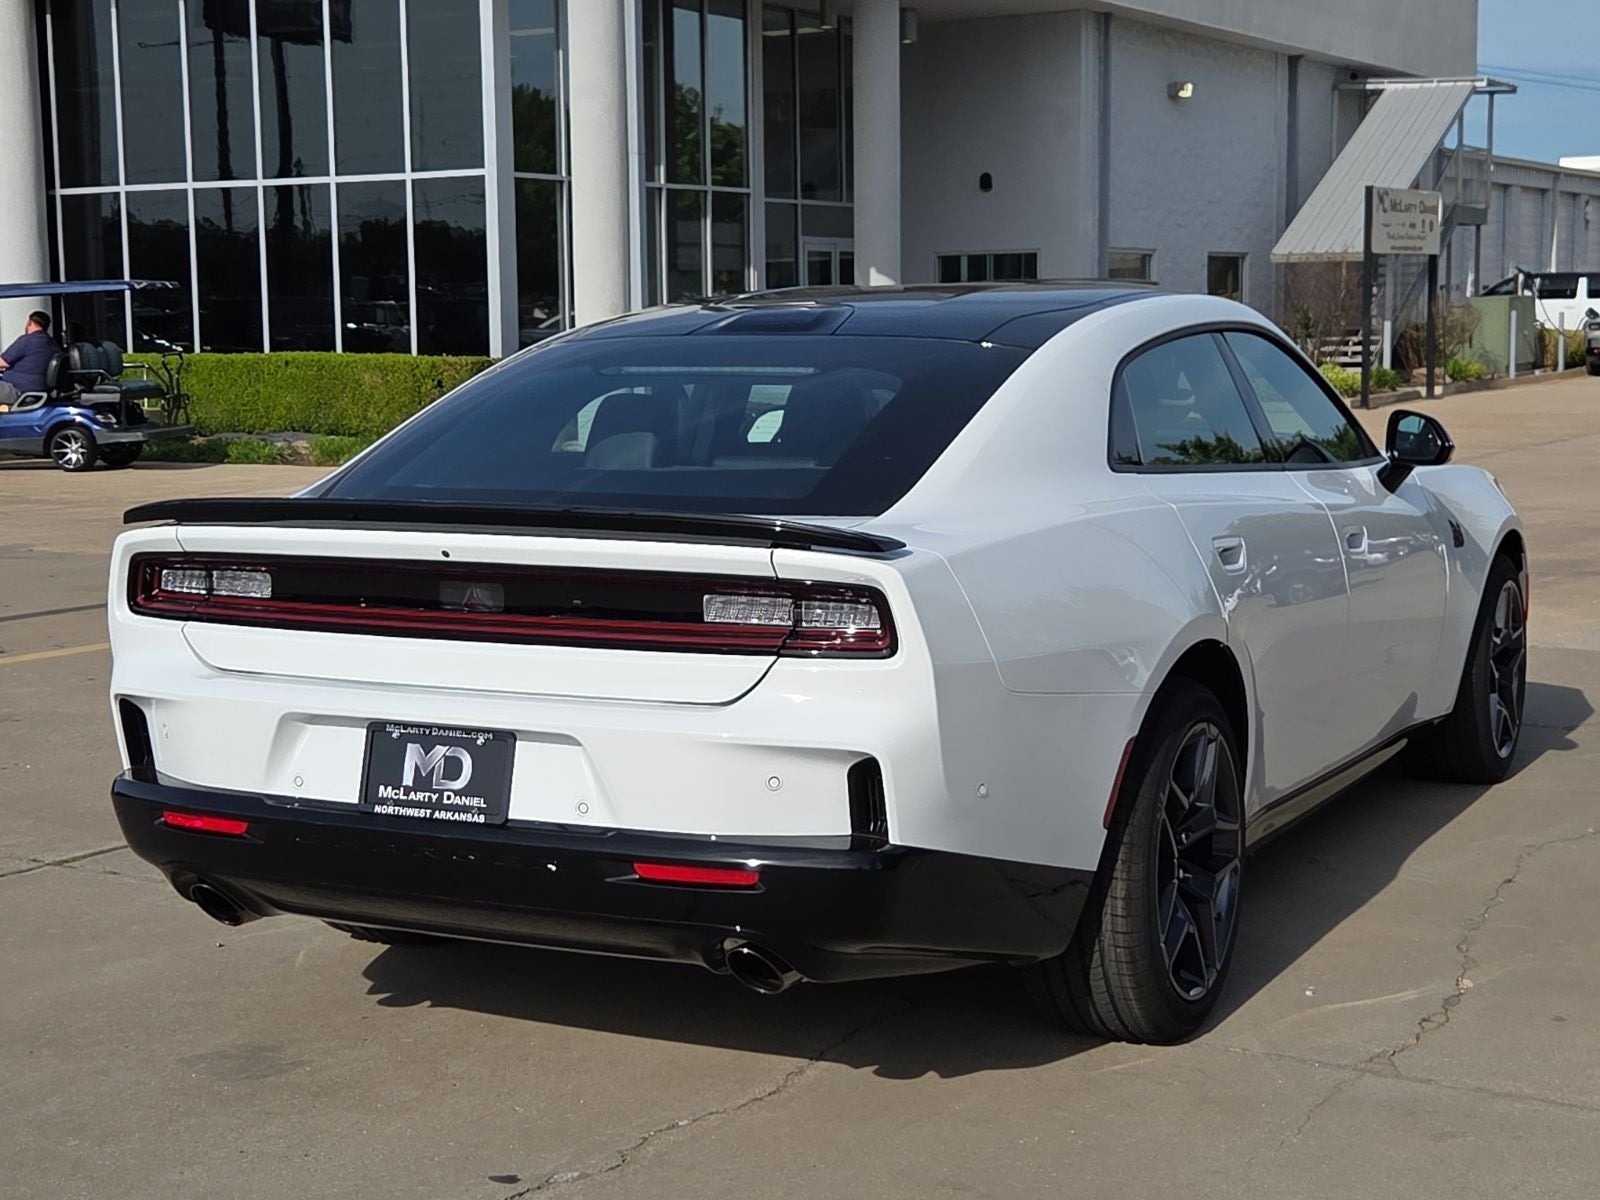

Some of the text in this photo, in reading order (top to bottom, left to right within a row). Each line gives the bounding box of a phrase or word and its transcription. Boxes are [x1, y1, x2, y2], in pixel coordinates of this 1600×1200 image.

[443, 791, 487, 808] DANIEL
[374, 804, 485, 823] NORTHWEST ARKANSAS
